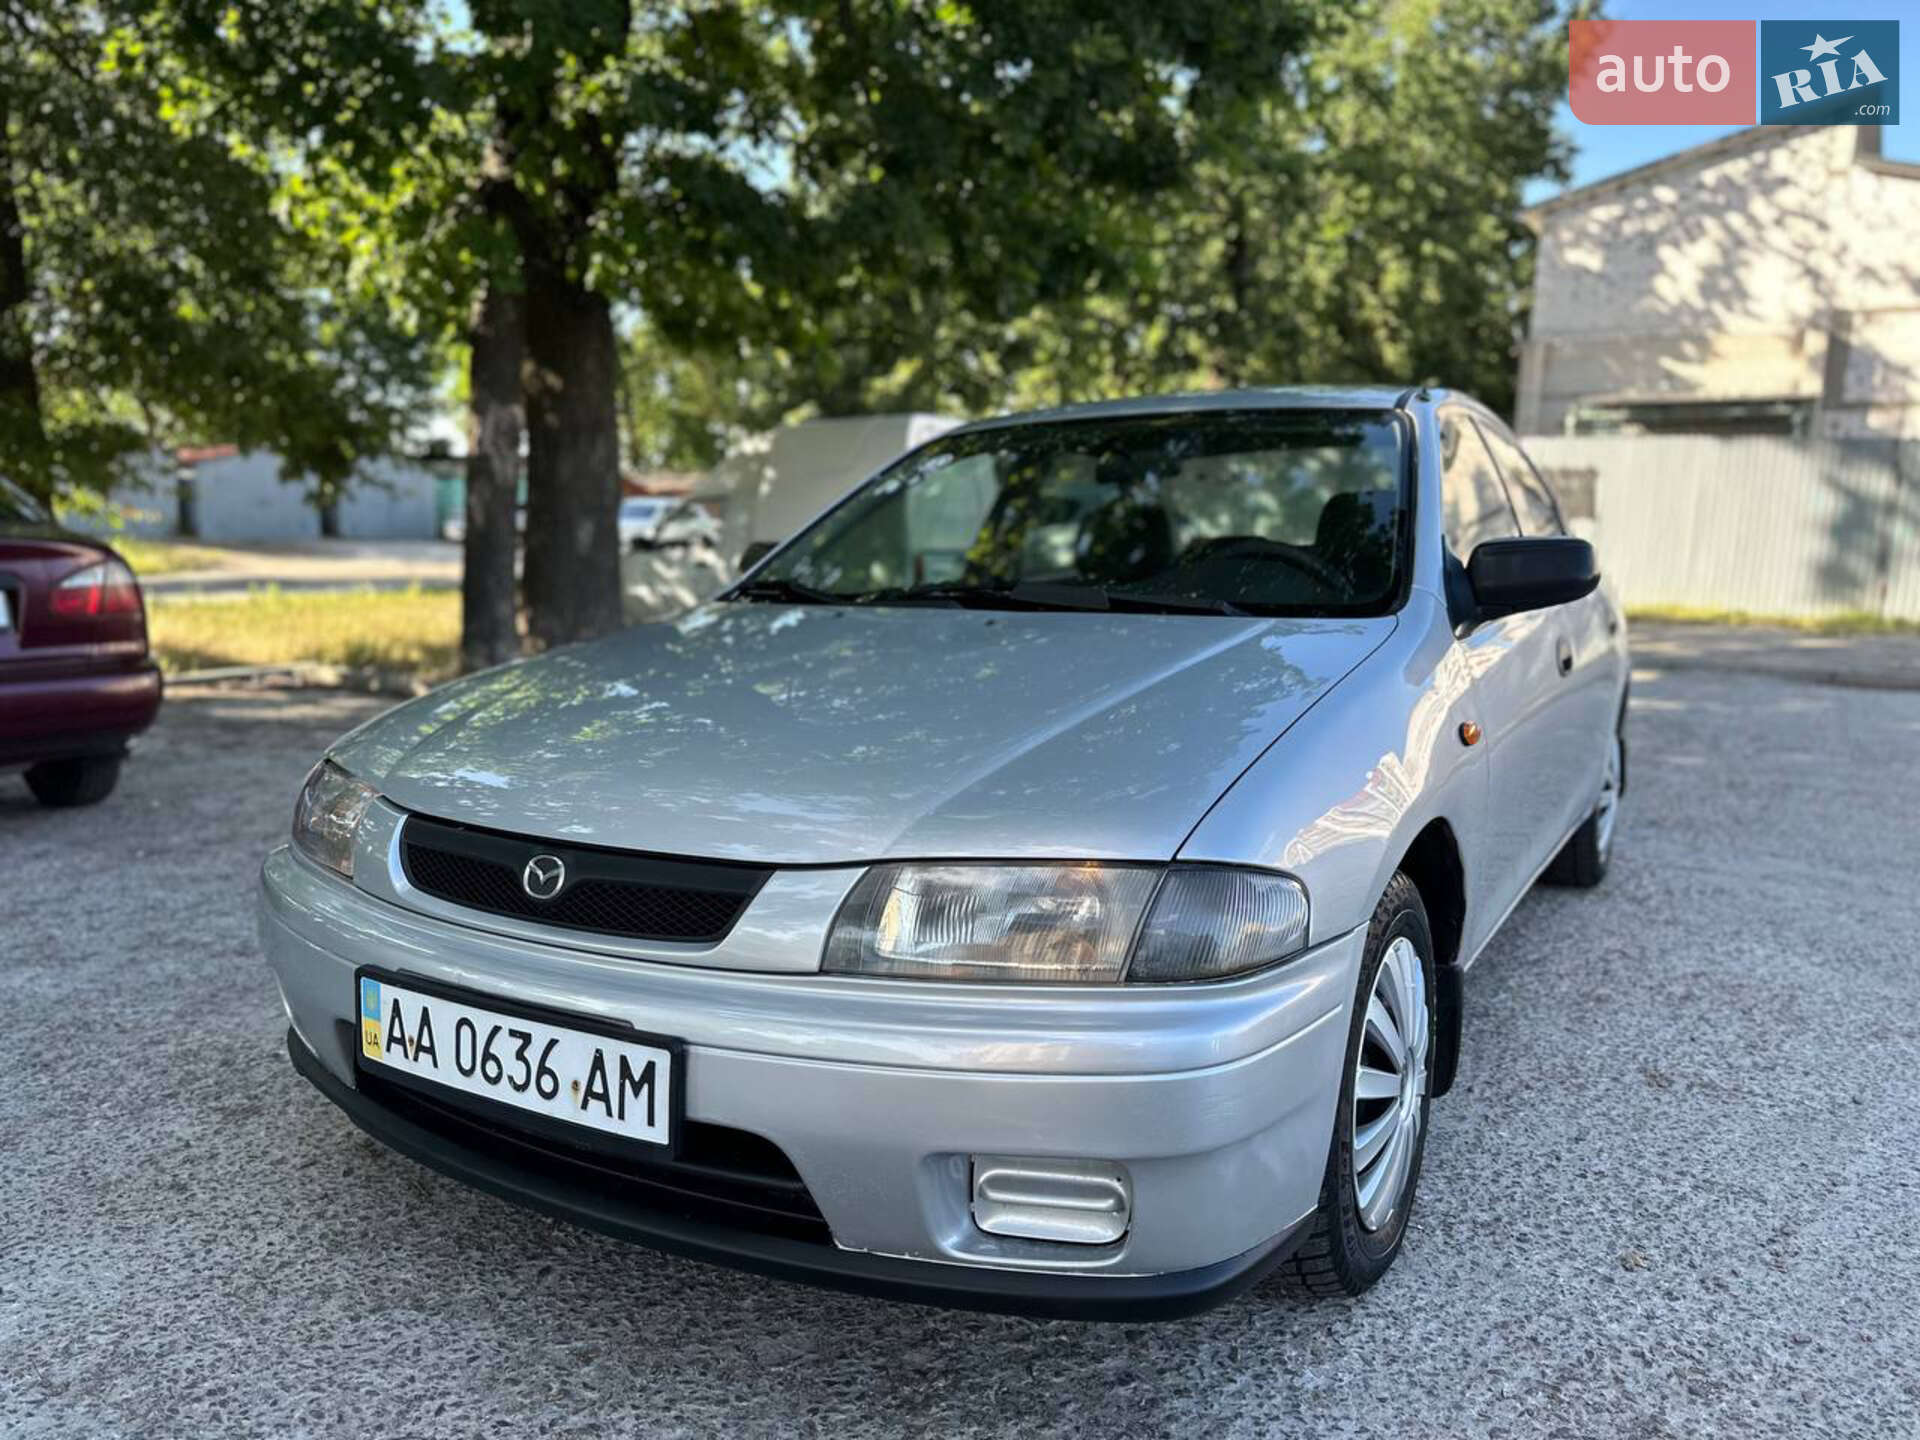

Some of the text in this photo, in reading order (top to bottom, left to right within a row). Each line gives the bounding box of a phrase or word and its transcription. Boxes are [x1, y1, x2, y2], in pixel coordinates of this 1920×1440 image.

[364, 1030, 380, 1049] UA
[385, 998, 656, 1128] AA 0636 AM
